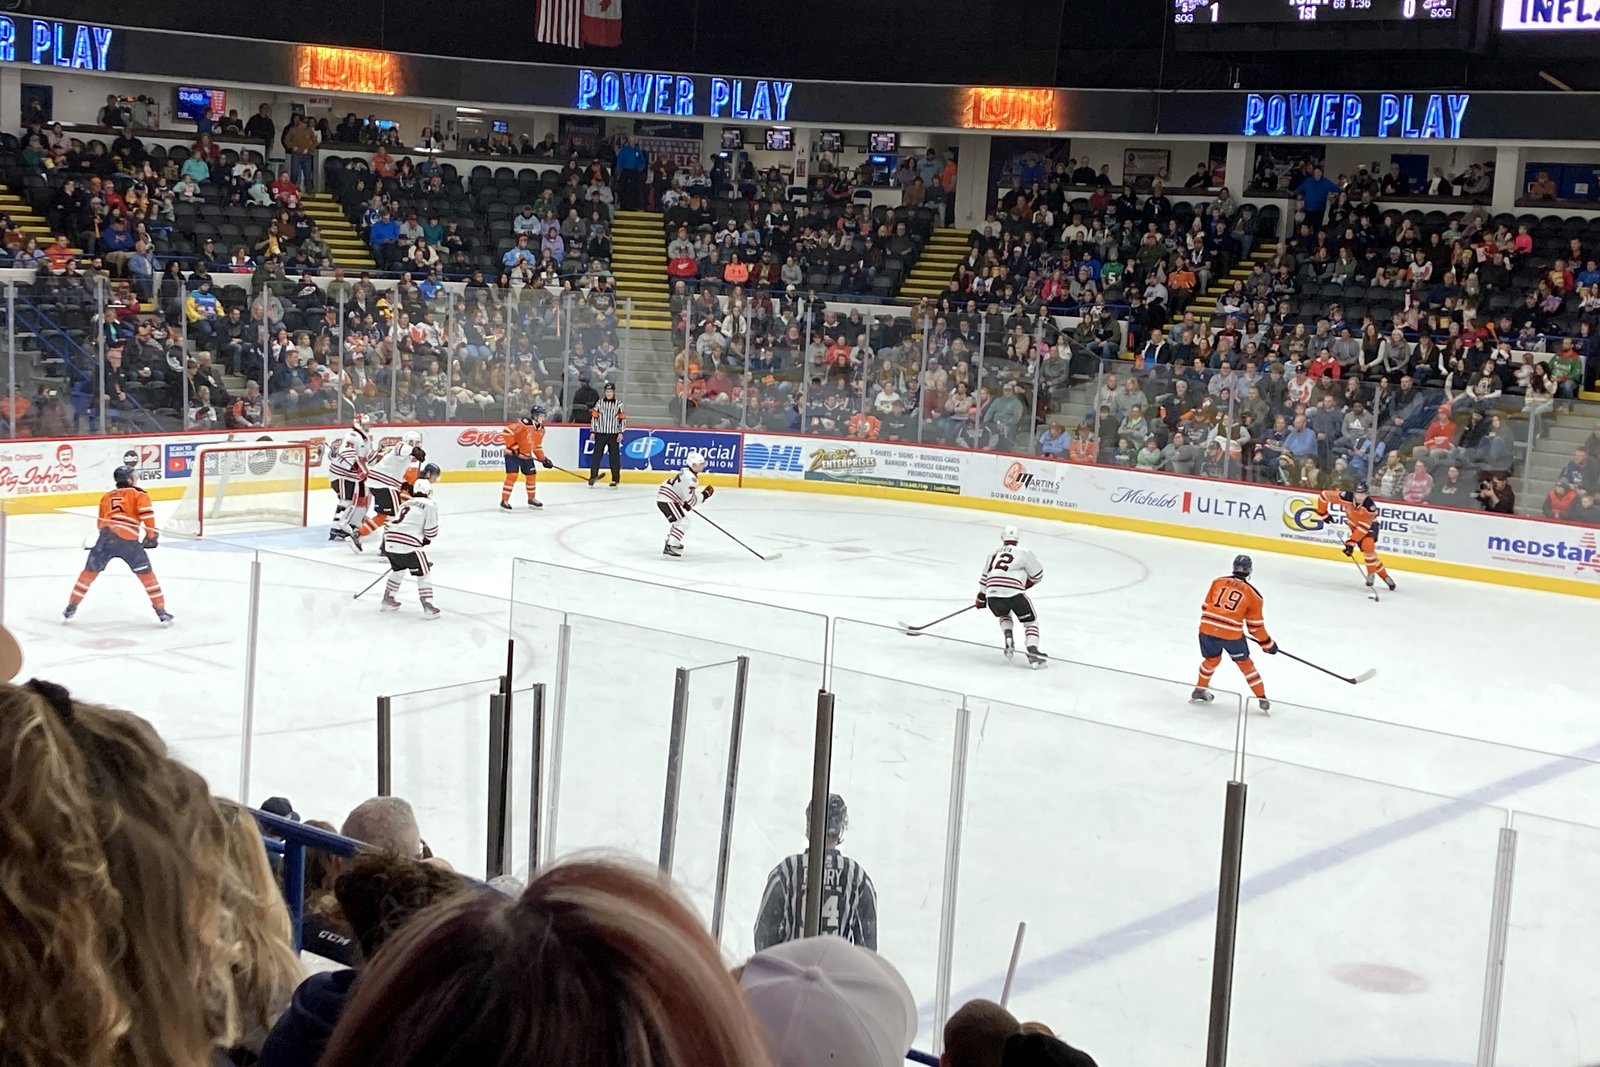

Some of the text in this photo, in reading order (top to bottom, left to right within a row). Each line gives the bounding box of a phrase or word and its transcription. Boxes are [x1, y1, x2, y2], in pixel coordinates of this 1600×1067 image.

[1175, 14, 1193, 22] SOG
[1210, 2, 1219, 22] 1
[1298, 5, 1317, 20] 1st
[1430, 8, 1452, 18] SOG
[32, 20, 113, 72] PLAY
[577, 69, 793, 121] POWER PLAY
[1243, 93, 1470, 139] POWER PLAY
[665, 443, 736, 459] Financial
[664, 459, 688, 467] CRED
[822, 457, 876, 469] ENTERPRISES
[884, 459, 960, 473] BANNERS VEHICLE GRAPHICS
[919, 454, 943, 462] BUSINESS
[944, 456, 961, 464] CARDS
[20, 466, 78, 486] John
[138, 471, 162, 481] NEWS
[907, 470, 959, 481] PROMOTIONAL ITEMS
[17, 486, 41, 494] STEAK
[51, 484, 79, 492] ONION
[111, 498, 125, 512] 5
[990, 491, 1025, 502] DOWNLOAD
[1056, 500, 1078, 509] TODAY!
[1110, 487, 1267, 521] Michelob ULTRA
[1383, 536, 1437, 550] DESIGN
[987, 552, 1015, 573] 12
[1213, 587, 1243, 611] 19
[318, 929, 350, 946] CCM
